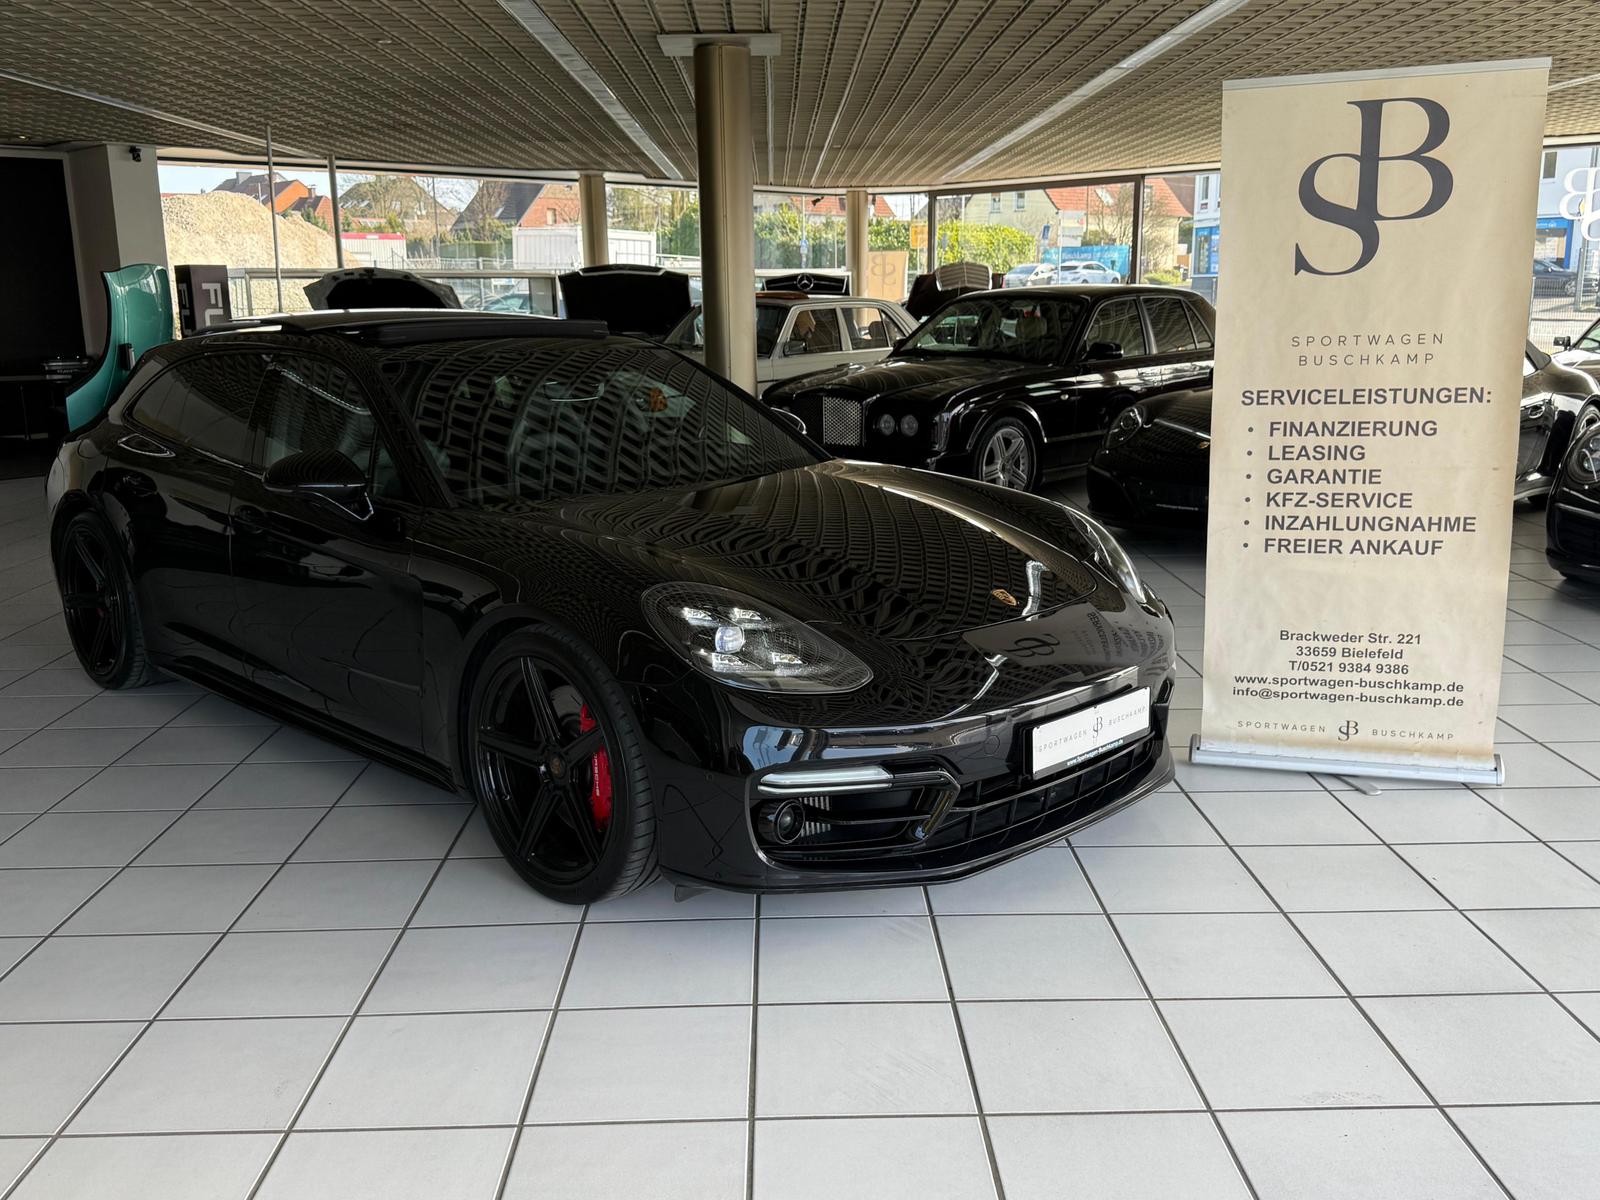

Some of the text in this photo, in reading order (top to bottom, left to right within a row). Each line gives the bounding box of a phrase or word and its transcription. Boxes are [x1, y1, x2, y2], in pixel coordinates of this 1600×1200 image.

[1291, 333, 1444, 347] SPORTWAGEN
[1298, 353, 1435, 366] BUSCHKAMP
[1241, 387, 1492, 406] SERVICELEISTUNGEN:
[1269, 420, 1438, 437] FINANZIERUNG
[1268, 445, 1366, 461] LEASING
[1267, 468, 1382, 485] GARANTIE
[1266, 492, 1413, 508] KFZ-SERVICE
[1264, 515, 1477, 533] INZAHLUNGNAHME
[1264, 538, 1444, 556] FREIER ANKAUF
[1279, 630, 1421, 645] Brackweder Str. 221
[1296, 646, 1403, 660] 33659 Bielefeld
[1289, 661, 1409, 675] T/0521 9384 9386
[1234, 675, 1464, 693] www.sportwagen-buschkamp.de
[1232, 687, 1464, 708] info@sportwagen-buschkamp.de
[1039, 729, 1088, 753] SPORTWAGEN
[1108, 706, 1147, 727] BUSCHKAMP
[1237, 720, 1327, 733] SPORTWAGEN
[1372, 729, 1455, 741] BUSCHKAMP
